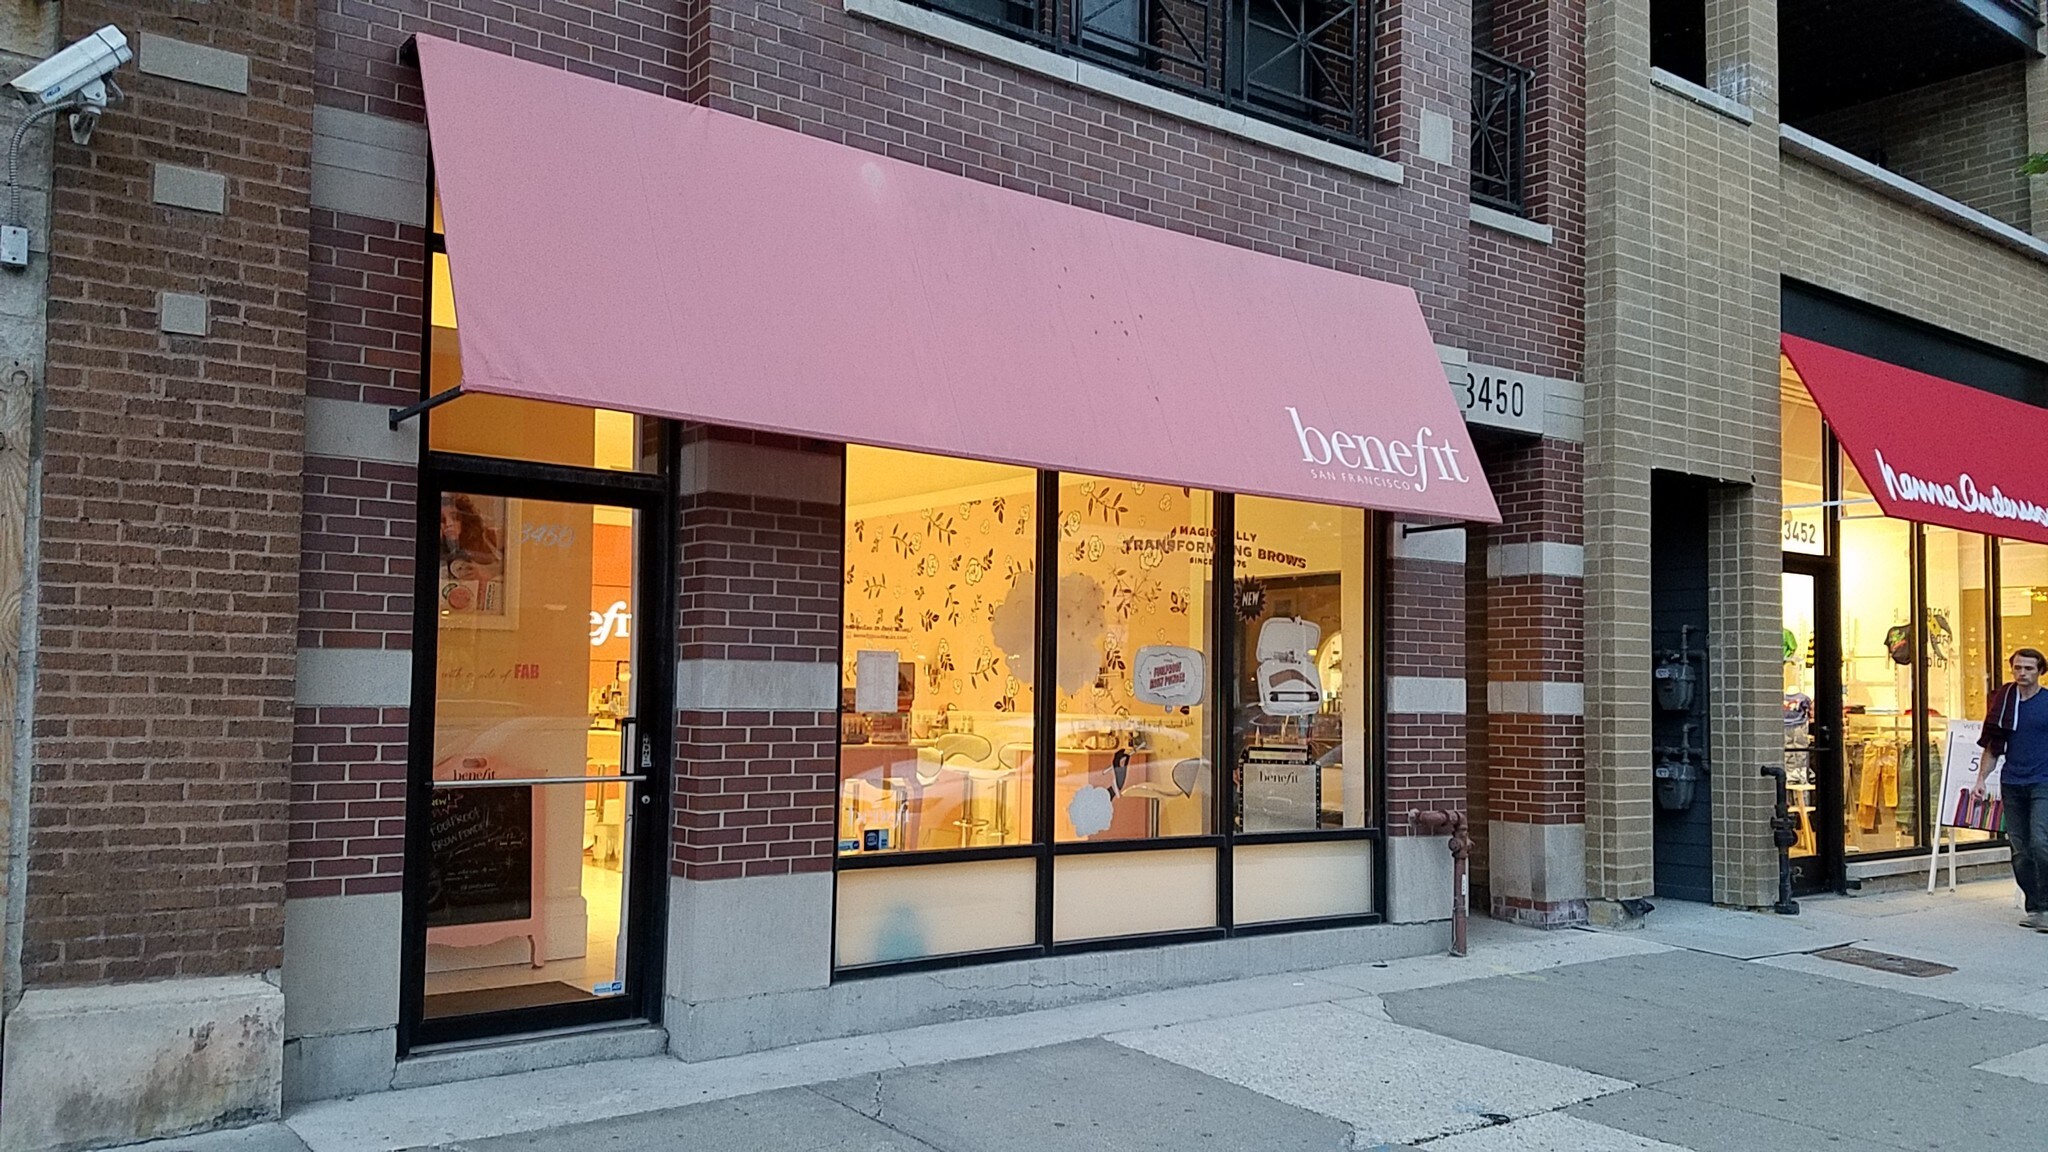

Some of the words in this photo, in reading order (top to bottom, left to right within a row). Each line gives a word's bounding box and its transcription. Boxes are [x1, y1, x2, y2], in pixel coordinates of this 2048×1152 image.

[1467, 372, 1524, 417] 3450
[1285, 406, 1470, 492] benefit
[1310, 469, 1336, 482] SAN
[1341, 472, 1411, 491] FRANCISCO
[1180, 526, 1257, 543] MAGICLLY
[1784, 520, 1816, 544] 3452
[1257, 548, 1307, 569] BROWS
[1242, 591, 1260, 607] NEW
[514, 663, 540, 679] FAB
[1259, 770, 1298, 785] benefit
